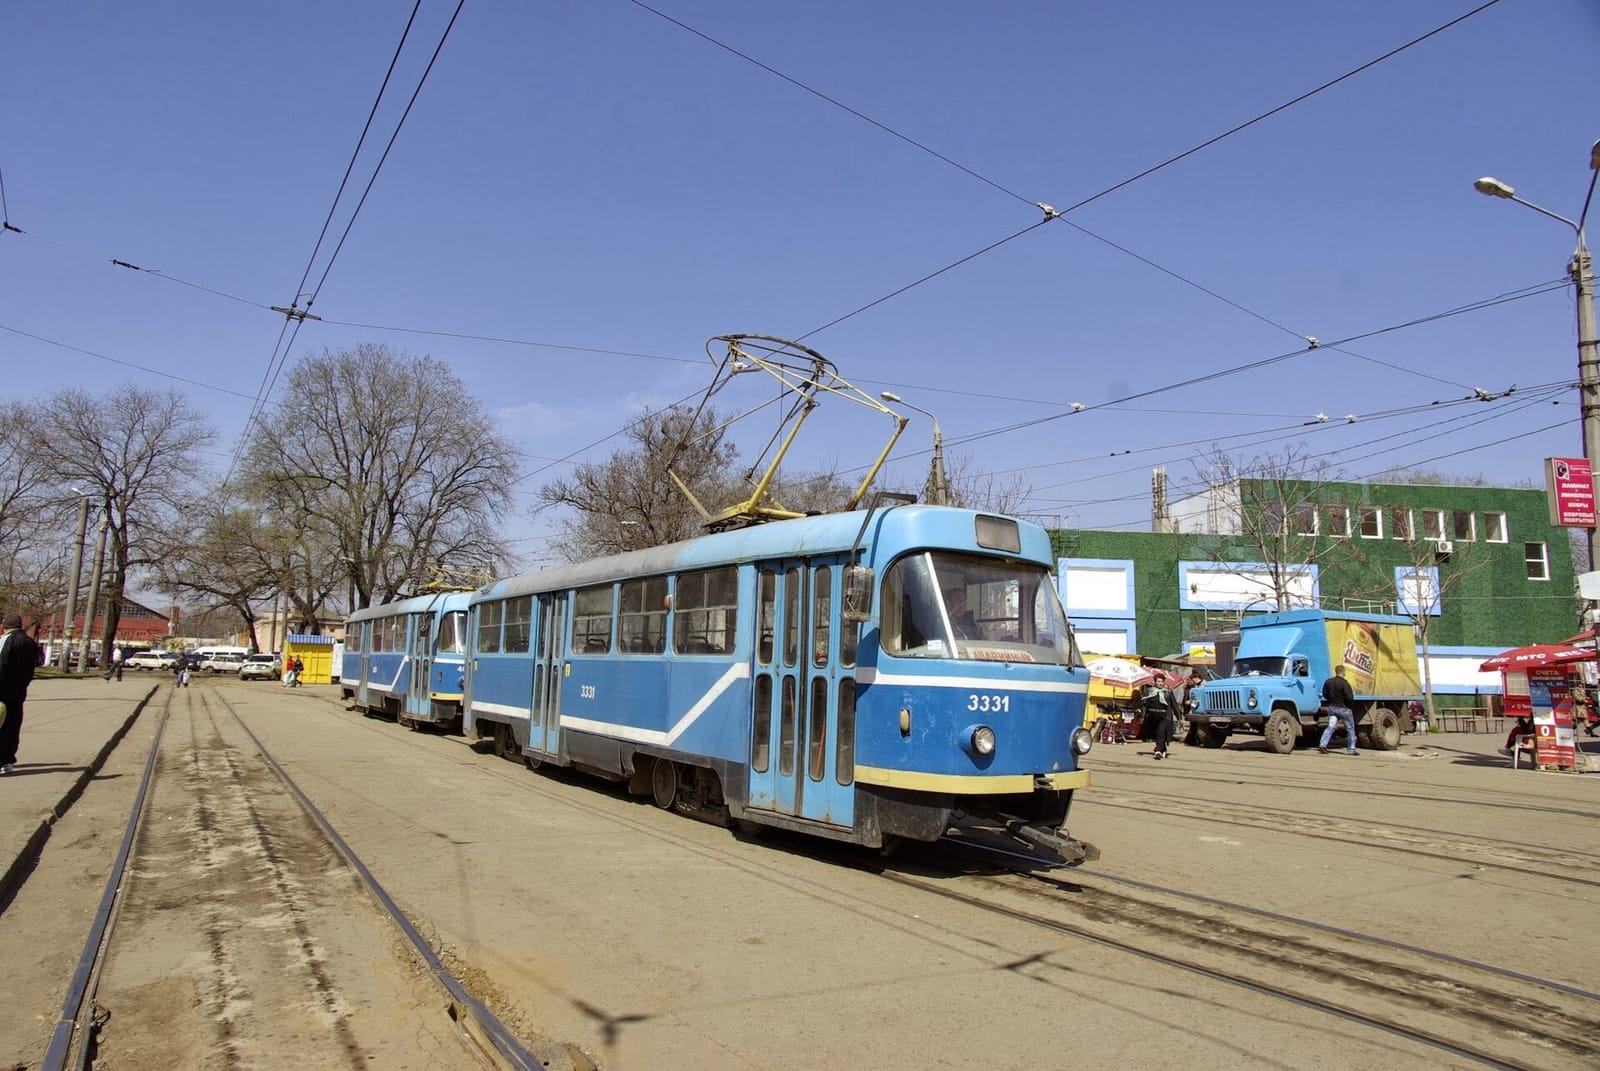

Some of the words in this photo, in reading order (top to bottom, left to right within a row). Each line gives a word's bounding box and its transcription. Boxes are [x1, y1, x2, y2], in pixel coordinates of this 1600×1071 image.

[1516, 653, 1546, 661] МТС
[581, 685, 596, 699] 3331
[967, 694, 1010, 713] 3331
